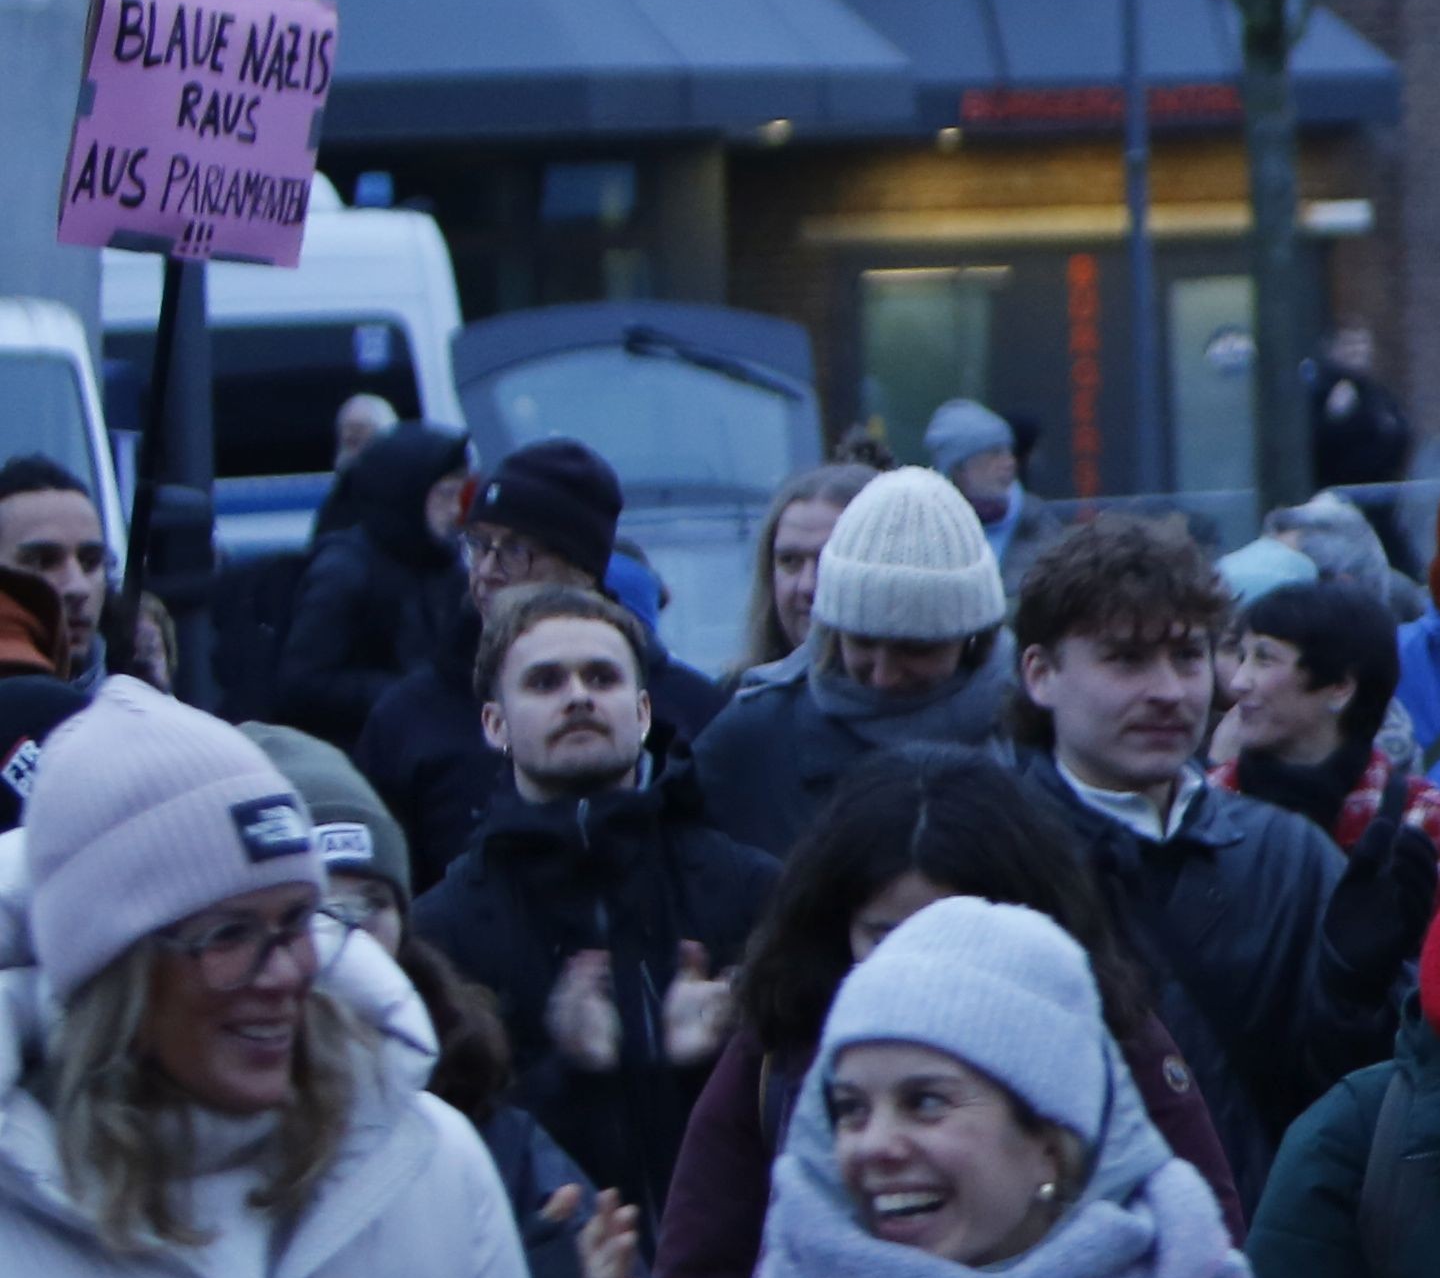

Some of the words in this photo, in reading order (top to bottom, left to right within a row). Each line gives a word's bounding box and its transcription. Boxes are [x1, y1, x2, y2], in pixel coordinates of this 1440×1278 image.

[239, 13, 333, 96] NAZIS
[178, 83, 260, 143] RAUS
[71, 139, 148, 208] AUS
[182, 221, 214, 253] !!!
